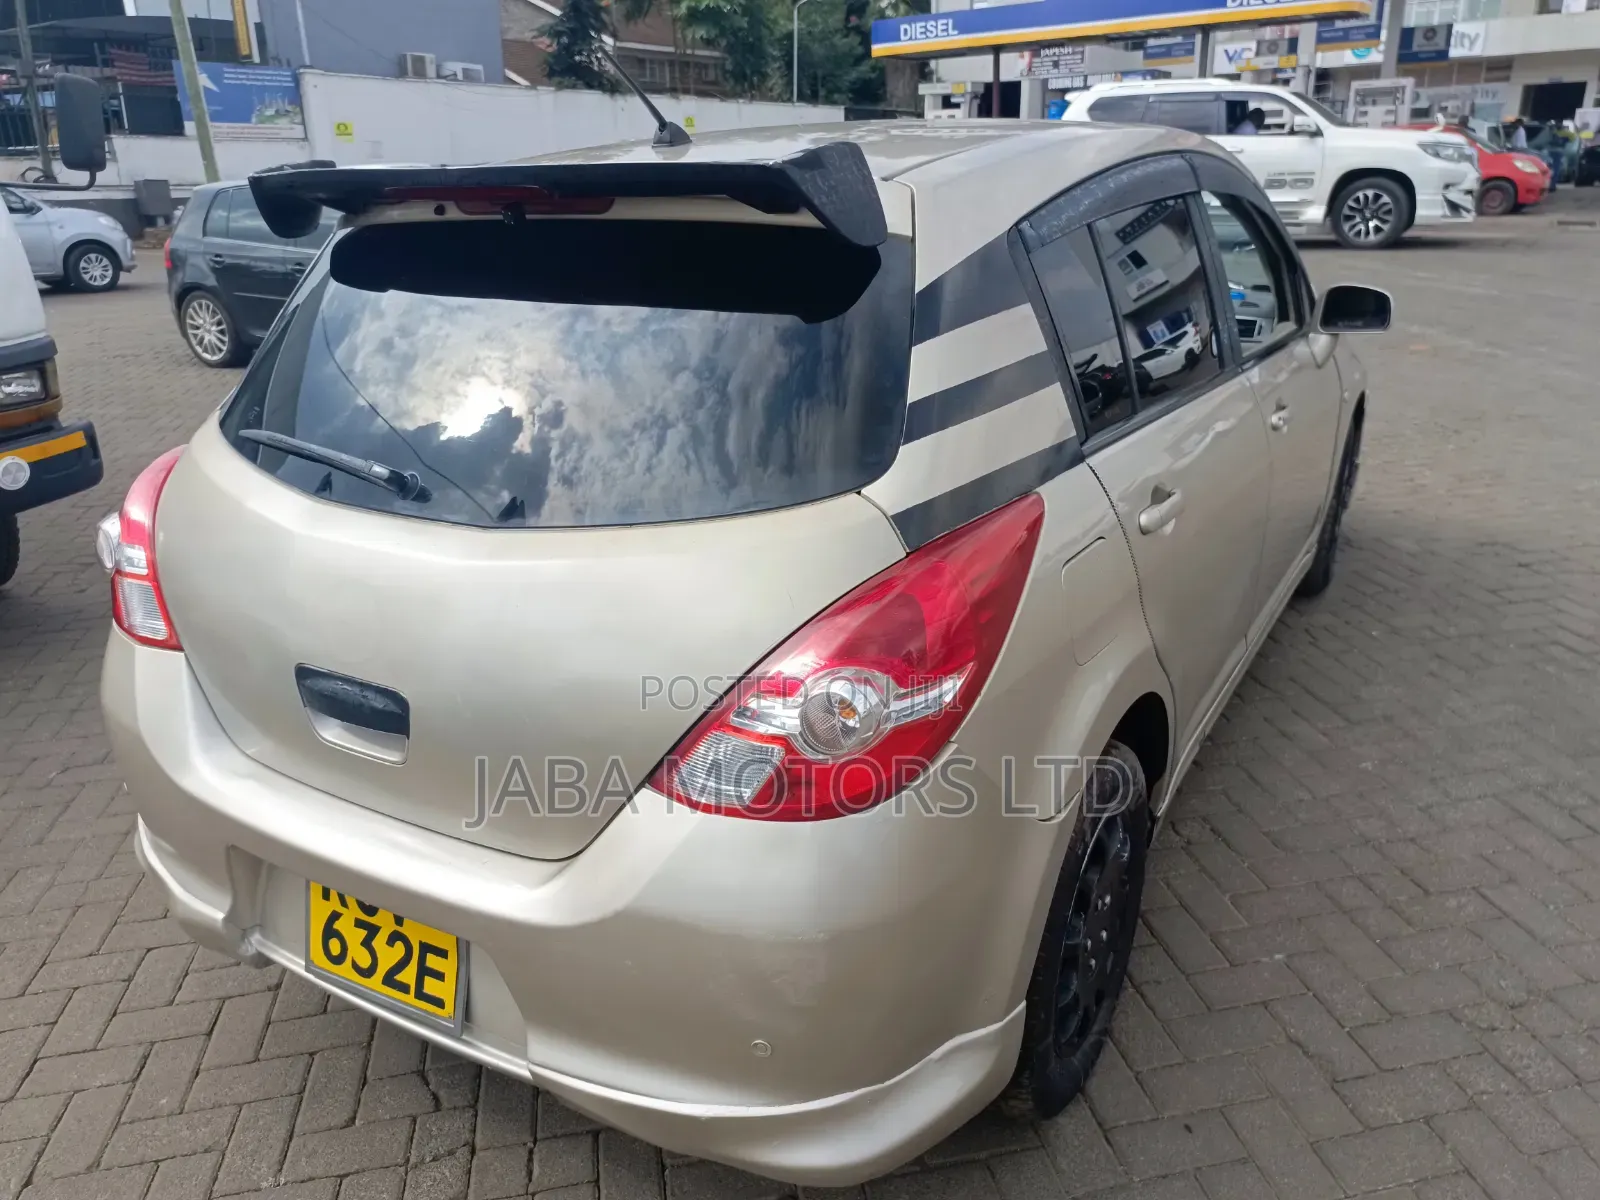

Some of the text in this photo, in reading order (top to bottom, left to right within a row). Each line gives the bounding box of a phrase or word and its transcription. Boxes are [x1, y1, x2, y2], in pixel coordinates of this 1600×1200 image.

[900, 19, 959, 41] DIESEL
[1452, 30, 1481, 52] ity
[321, 909, 449, 1010] 632E
